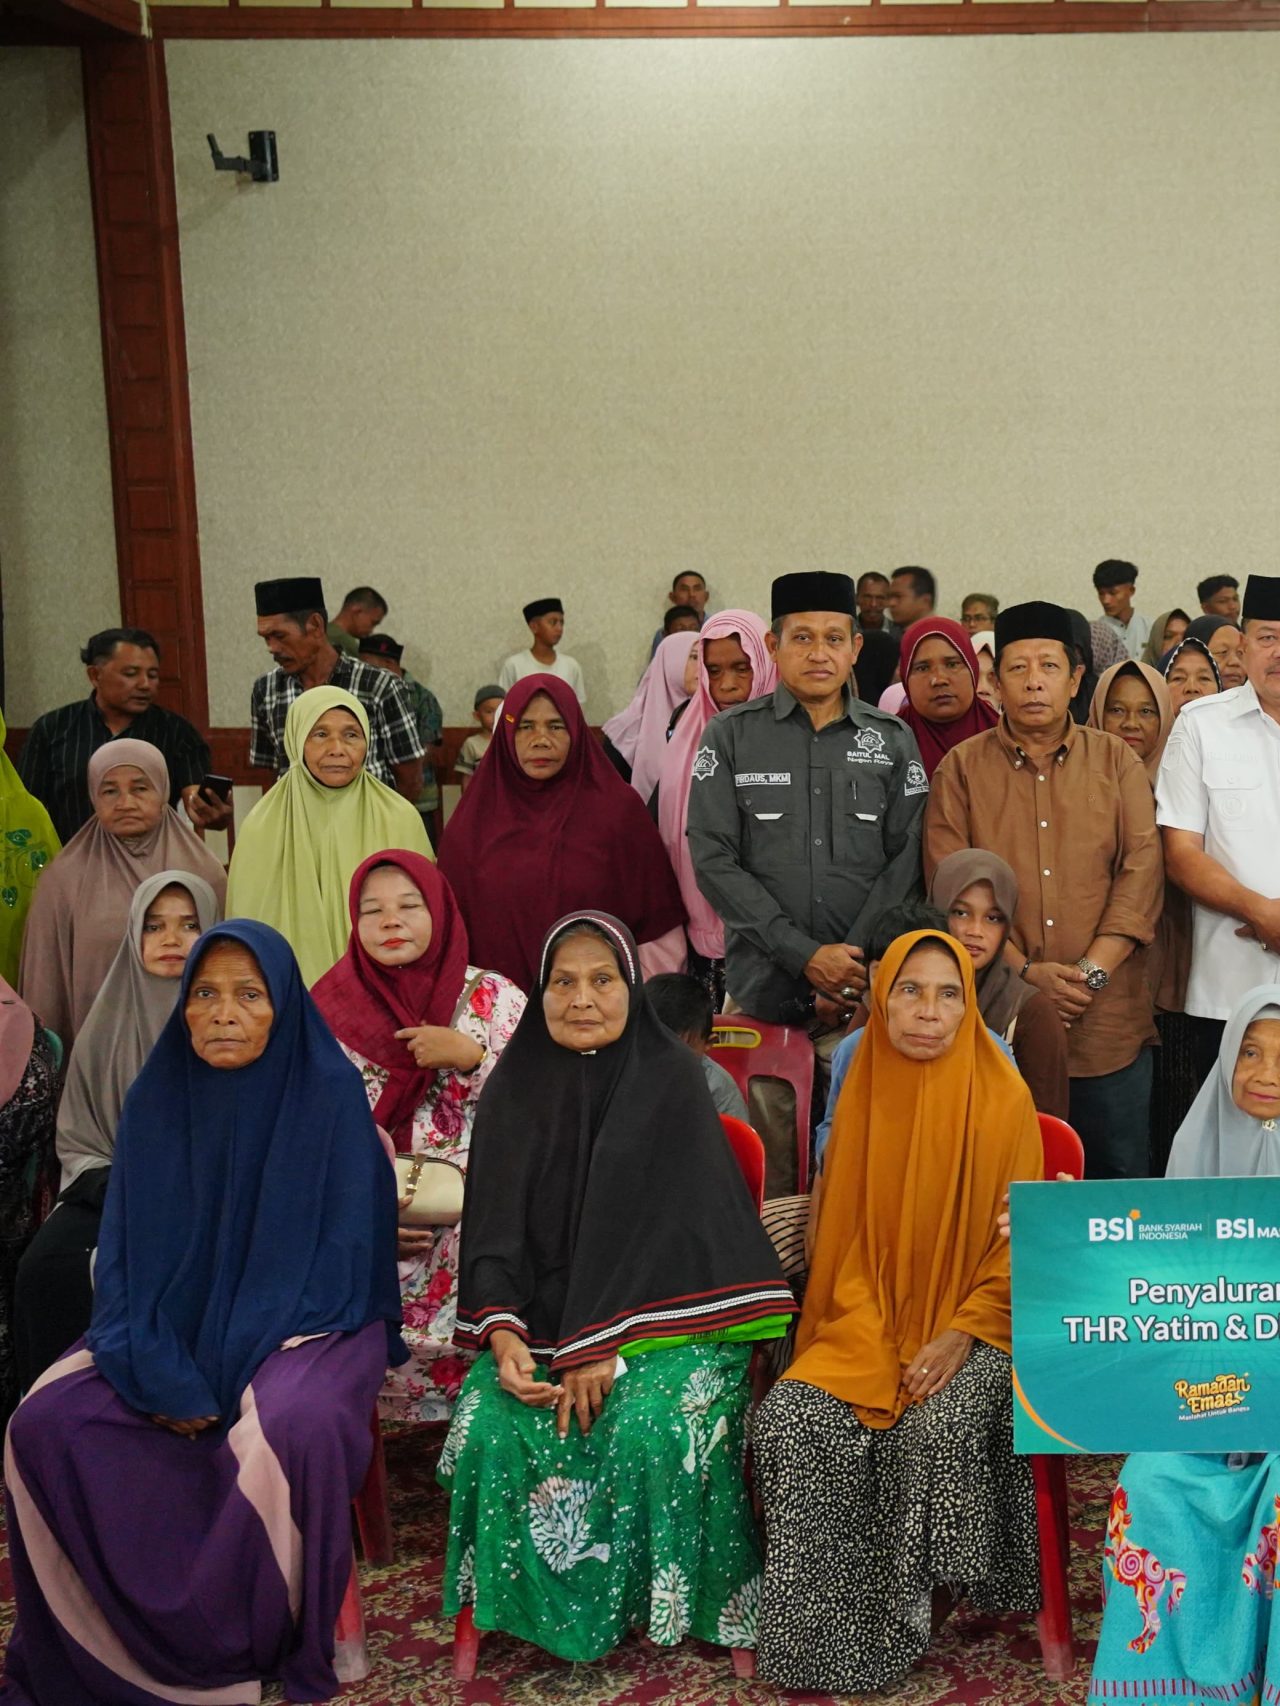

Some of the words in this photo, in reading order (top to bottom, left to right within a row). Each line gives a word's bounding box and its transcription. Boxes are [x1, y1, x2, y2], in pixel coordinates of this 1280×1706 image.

[1089, 1217, 1134, 1241] BSI
[1139, 1224, 1163, 1232] BANK
[1164, 1223, 1203, 1231] SYARIAH
[1139, 1232, 1188, 1240] INDONESIA
[1216, 1218, 1255, 1239] BSI
[1063, 1316, 1128, 1342] THR
[1133, 1315, 1219, 1341] Yatim
[1225, 1314, 1249, 1340] &
[1174, 1374, 1251, 1397] Ramadan
[1187, 1392, 1240, 1413] Emas
